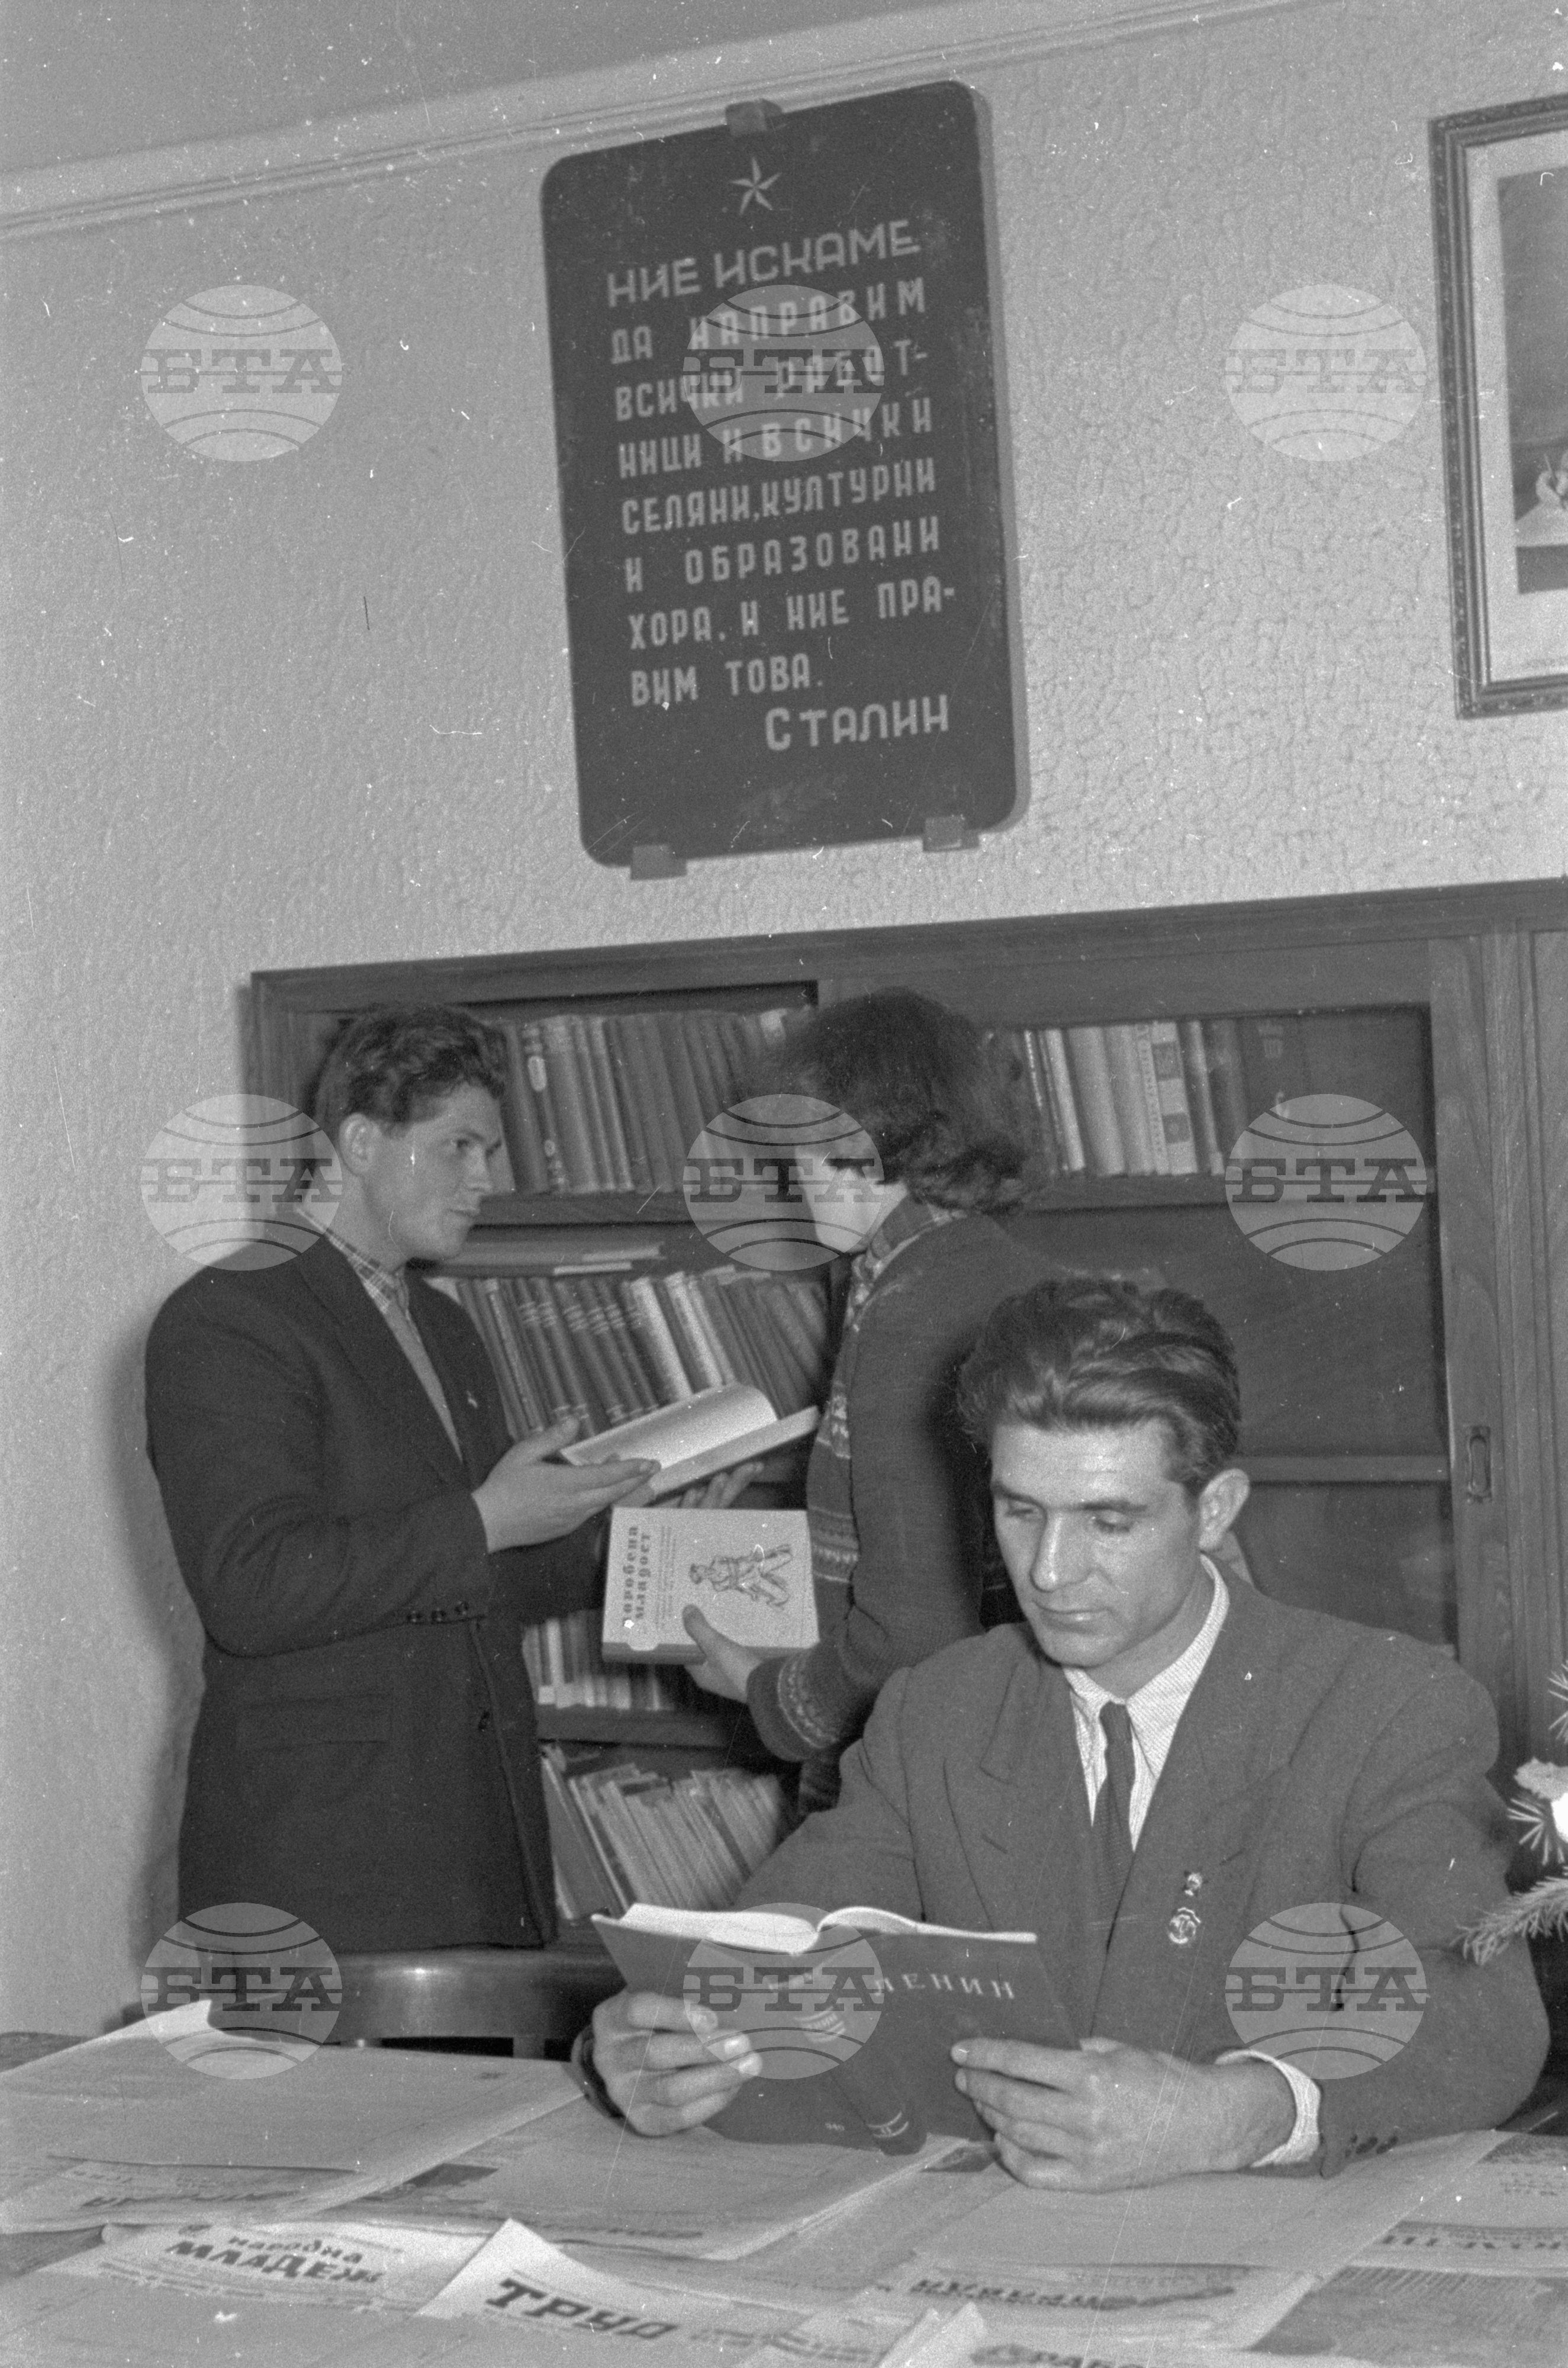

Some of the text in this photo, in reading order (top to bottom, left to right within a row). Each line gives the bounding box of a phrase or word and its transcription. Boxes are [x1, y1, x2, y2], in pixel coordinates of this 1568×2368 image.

[607, 220, 921, 308] НИЕ ИСКАМЕ
[610, 276, 925, 365] ДА НАПРАВИМ
[615, 339, 928, 422] ВСИЧКИ РАБОТ-
[619, 397, 932, 478] НИЦИ И ВСИЧКИ
[625, 516, 939, 593] И ОБРАЗОВАНИ
[629, 575, 955, 649] ХОРА. И НИЕ ПРА-
[631, 653, 823, 707] ВИМ ТОВА.
[765, 694, 948, 751] СТАЛИН
[872, 1972, 1015, 1999] ЛЕНИН
[166, 2241, 384, 2283] МЛАДЕЖ
[485, 2277, 681, 2340] ТРУД
